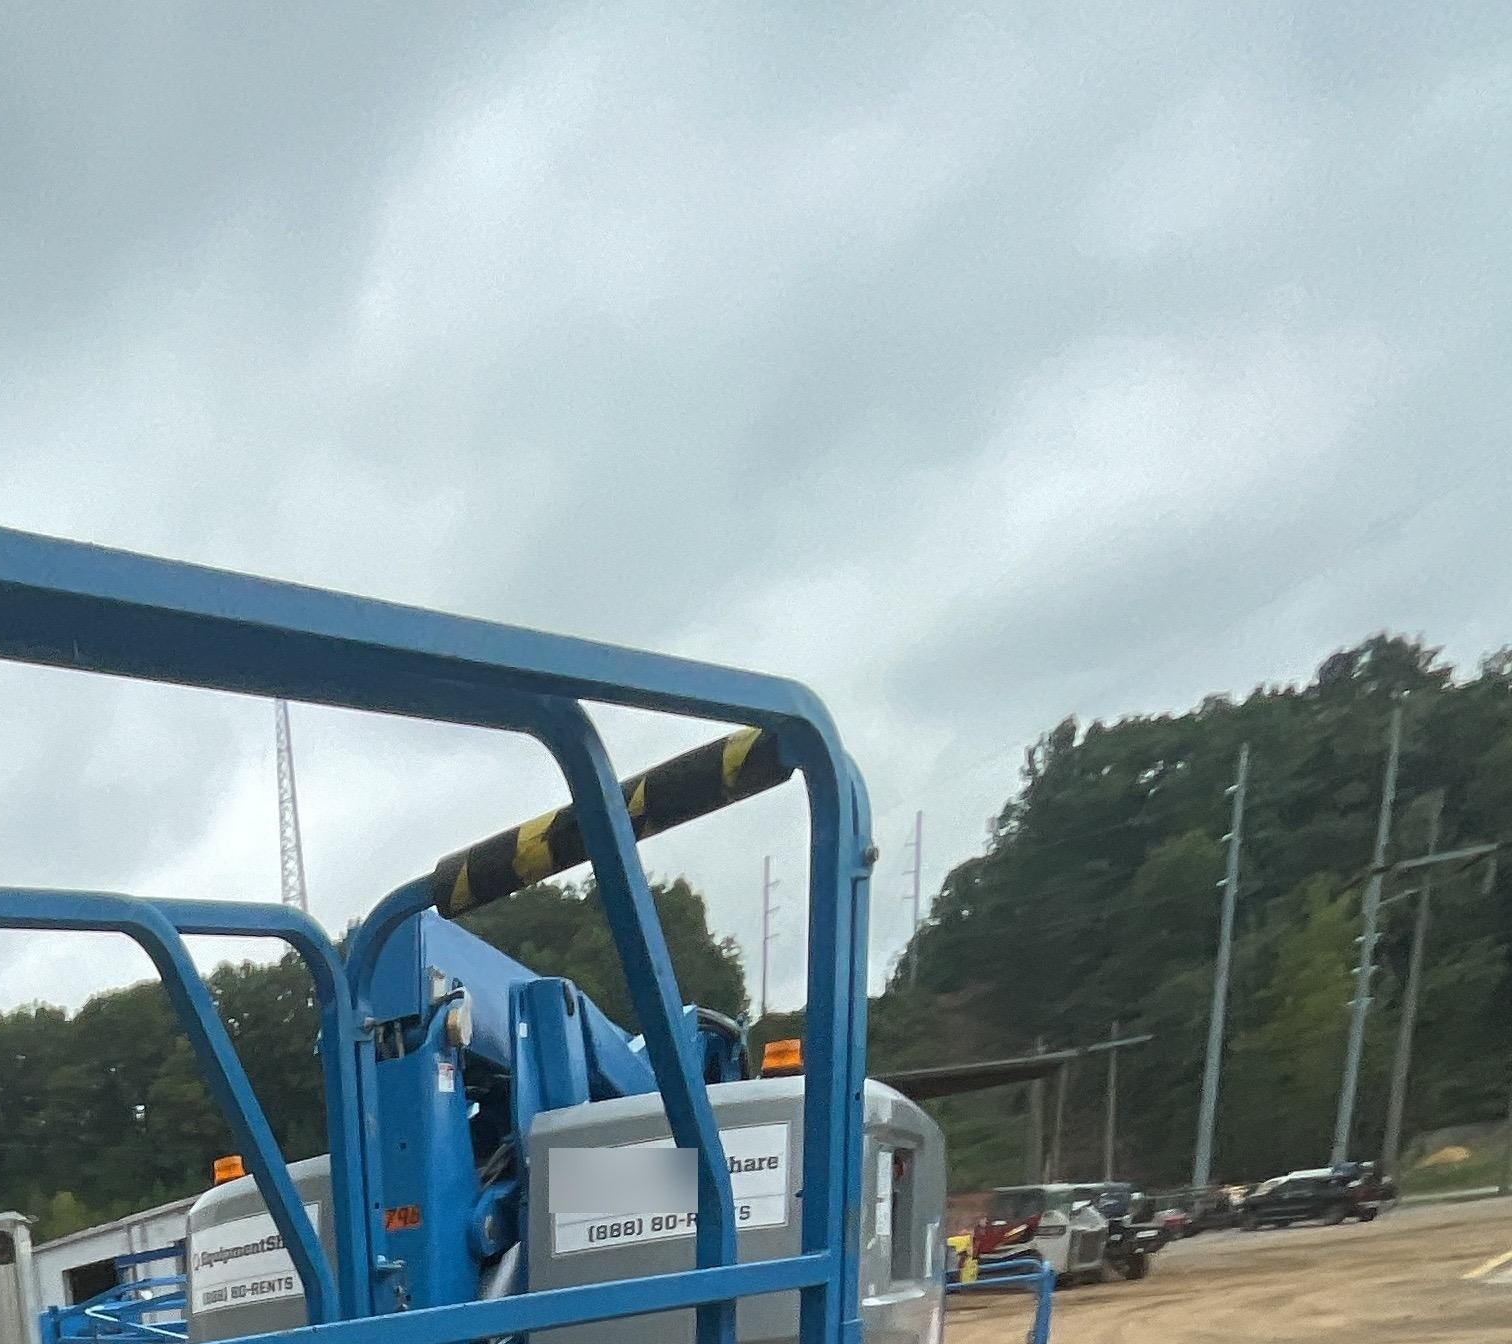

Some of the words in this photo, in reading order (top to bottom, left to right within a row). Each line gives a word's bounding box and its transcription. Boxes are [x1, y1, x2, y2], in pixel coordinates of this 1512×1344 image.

[588, 1218, 643, 1243] (888)
[201, 1235, 285, 1267] EquipmentSh
[231, 1276, 294, 1299] 80-RENTS
